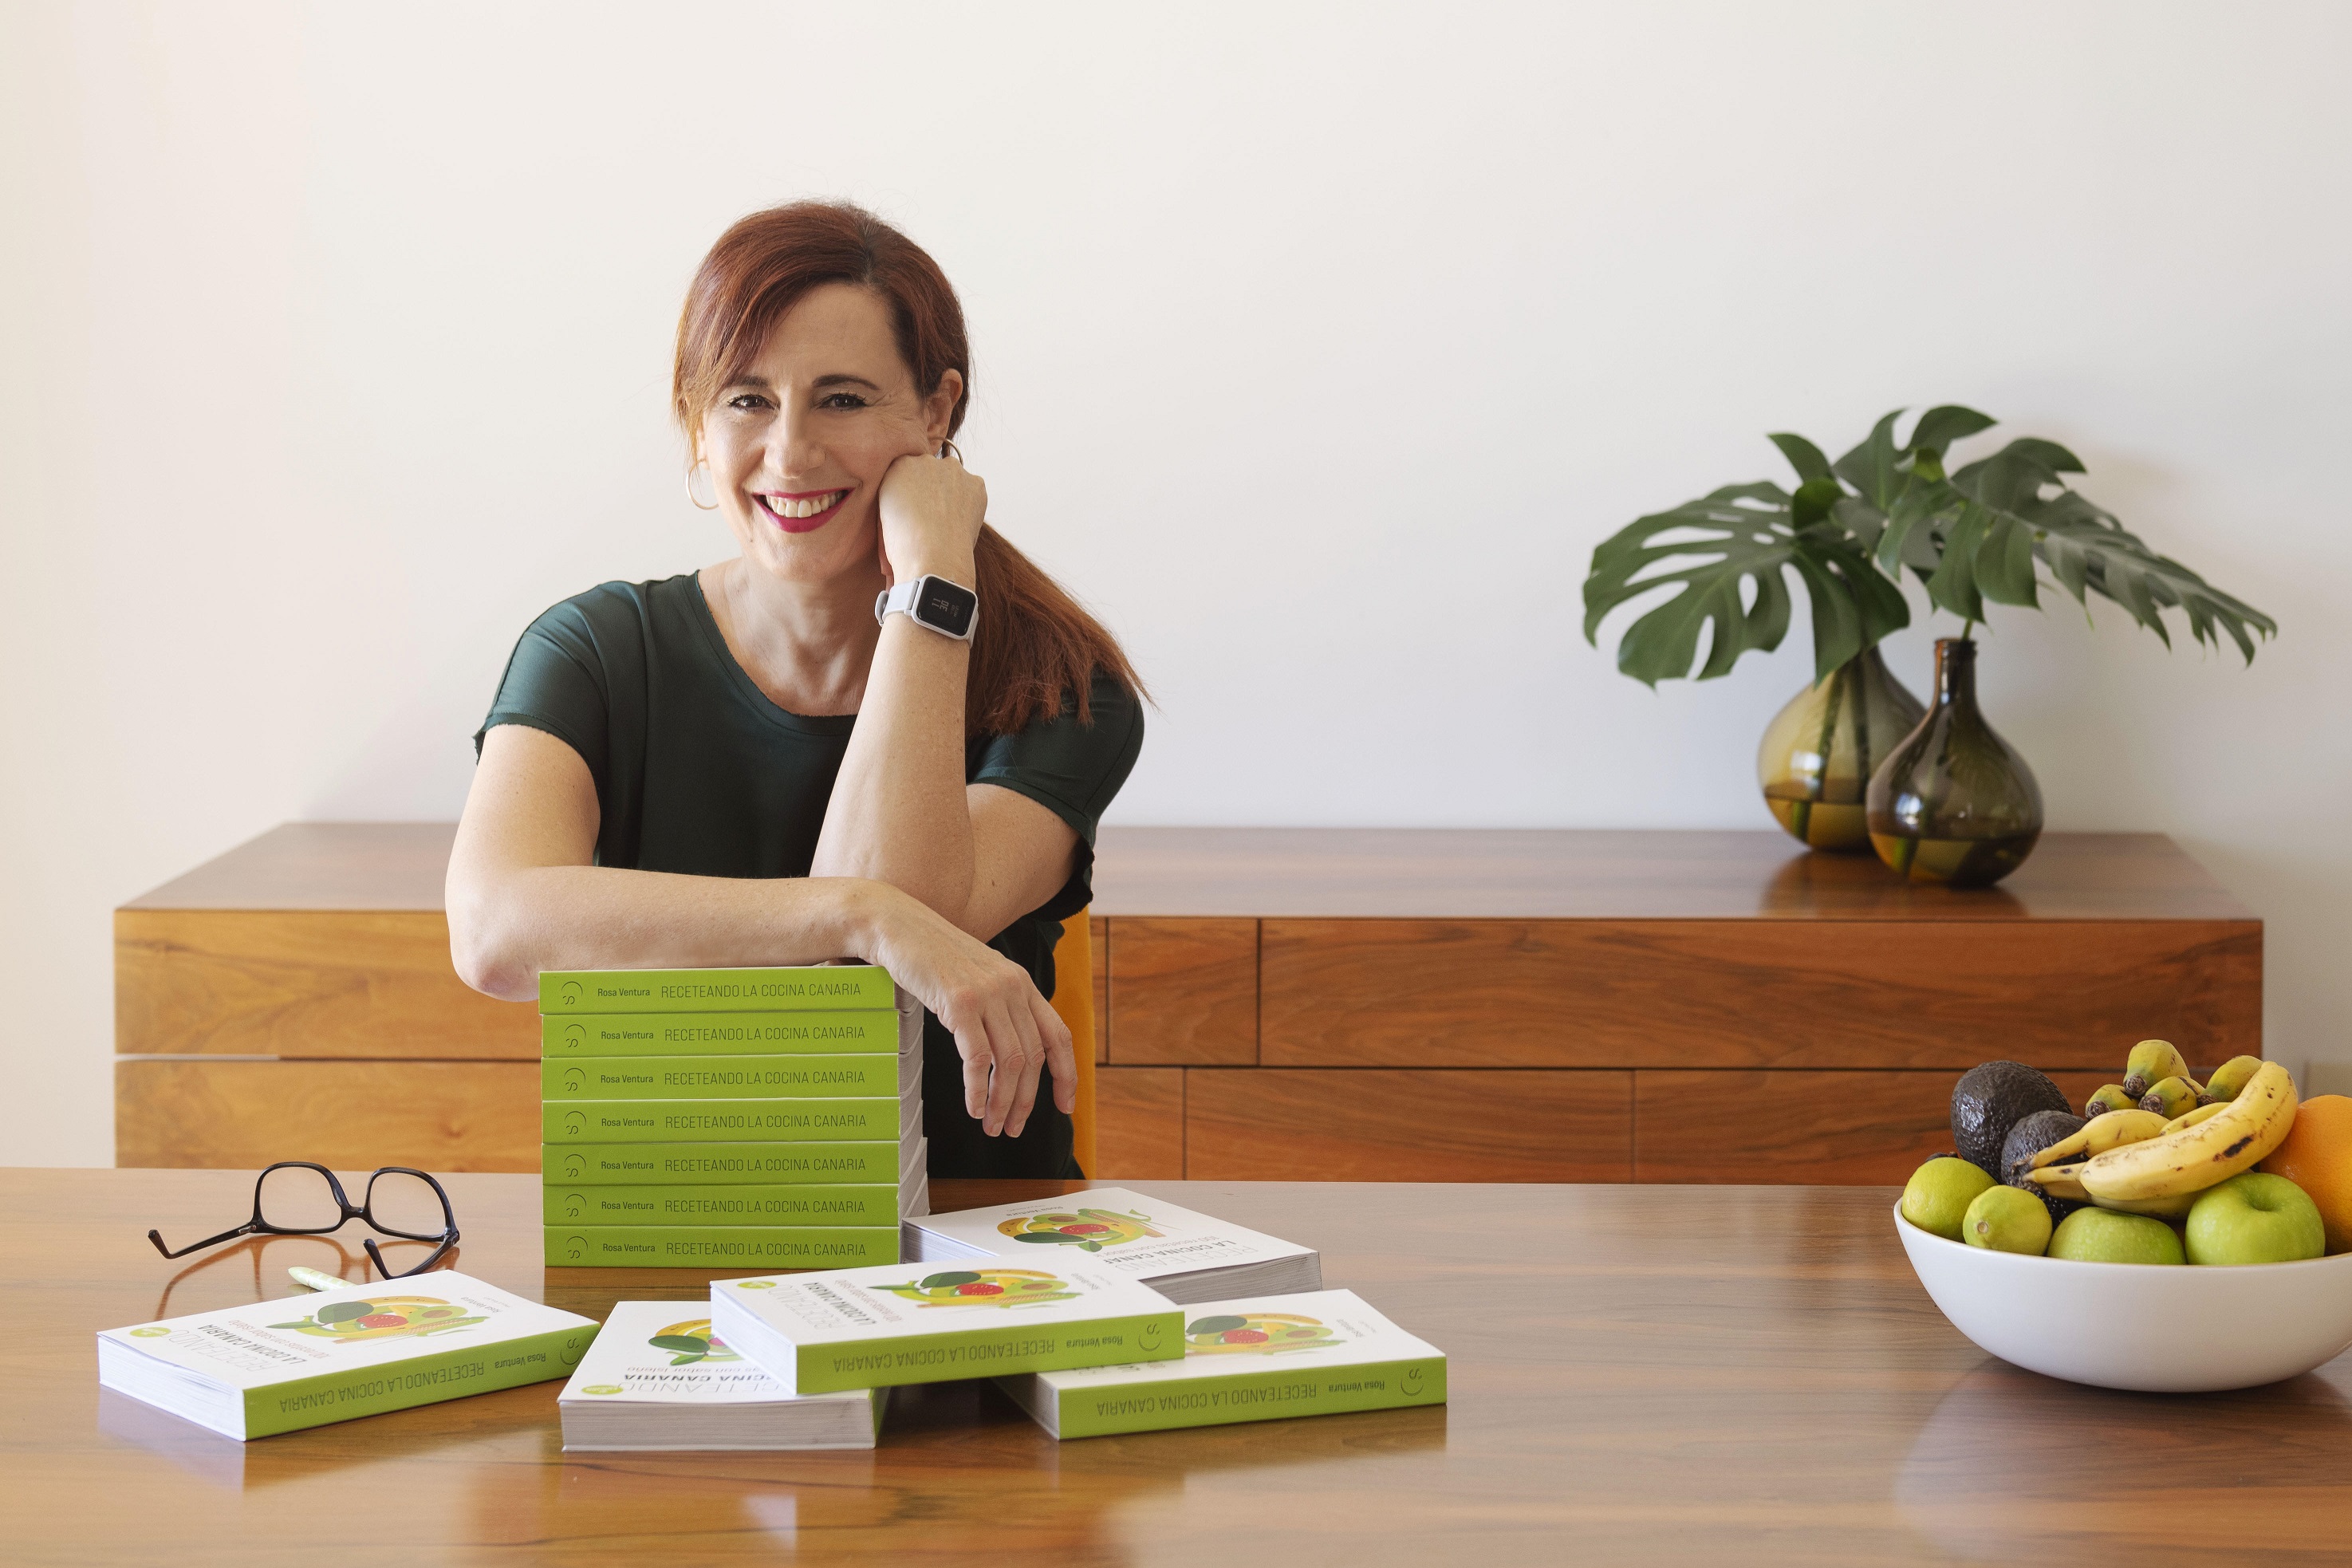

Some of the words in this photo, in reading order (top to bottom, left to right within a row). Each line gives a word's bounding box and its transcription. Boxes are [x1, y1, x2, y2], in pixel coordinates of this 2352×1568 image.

[597, 988, 617, 997] Rosa
[661, 984, 739, 999] RECETEANDO
[743, 984, 758, 997] LA
[761, 984, 806, 997] COCINA
[809, 983, 861, 996] CANARIA
[601, 1030, 621, 1040] Rosa
[622, 1030, 654, 1039] Ventura
[664, 1027, 743, 1042] RECETEANDO
[747, 1028, 762, 1040] LA
[765, 1027, 810, 1040] COCINA
[813, 1026, 865, 1039] CANARIA
[601, 1074, 621, 1084] Rosa
[621, 1074, 653, 1083] Ventura
[664, 1072, 743, 1085] RECETEANDO
[747, 1072, 761, 1085] LA
[765, 1071, 810, 1085] COCINA
[813, 1070, 865, 1084] CANARIA
[601, 1118, 621, 1127] Rosa
[622, 1117, 655, 1127] Ventura
[665, 1115, 744, 1129] RECETEANDO
[747, 1116, 762, 1128] LA
[766, 1115, 810, 1128] COCINA
[814, 1114, 866, 1128] CANARIA
[601, 1160, 621, 1170] Rosa
[622, 1160, 654, 1169] Ventura
[665, 1159, 744, 1172] RECETEANDO
[747, 1159, 762, 1171] LA
[766, 1159, 810, 1171] COCINA
[814, 1158, 865, 1171] CANARIA
[601, 1201, 621, 1210] Rosa
[622, 1201, 654, 1210] Ventura
[665, 1200, 743, 1212] RECETEANDO
[747, 1200, 762, 1212] LA
[765, 1200, 809, 1213] COCINA
[813, 1200, 865, 1213] CANARIA
[603, 1243, 622, 1252] Rosa
[624, 1243, 656, 1252] Ventura
[666, 1243, 745, 1255] RECETEANDO
[748, 1243, 762, 1255] LA
[766, 1243, 810, 1255] COCINA
[814, 1243, 866, 1256] CANARIA
[1153, 1244, 1213, 1255] COCINA
[1115, 1245, 1259, 1271] RECETEAND
[197, 1324, 252, 1345] CANARIA
[1101, 1336, 1122, 1345] Rosa
[969, 1339, 1054, 1360] RECETEANDO
[1066, 1338, 1099, 1348] Ventura
[242, 1343, 291, 1359] COCINA
[896, 1349, 944, 1367] COCINA
[948, 1347, 965, 1362] LA
[282, 1356, 307, 1365] LA
[494, 1356, 526, 1369] Ventura
[527, 1353, 546, 1364] Rosa
[833, 1355, 892, 1372] CANARIA
[406, 1362, 484, 1389] RECETEANDO
[624, 1373, 711, 1382] CANARIA
[388, 1378, 404, 1393] LA
[1328, 1383, 1361, 1393] Ventura
[1364, 1381, 1385, 1390] Rosa
[339, 1383, 384, 1403] COCINA
[1211, 1391, 1228, 1405] LA
[1231, 1384, 1316, 1404] RECETEANDO
[280, 1393, 335, 1412] CANARIA
[1097, 1396, 1155, 1416] CANARIA
[1159, 1394, 1208, 1412] COCINA
